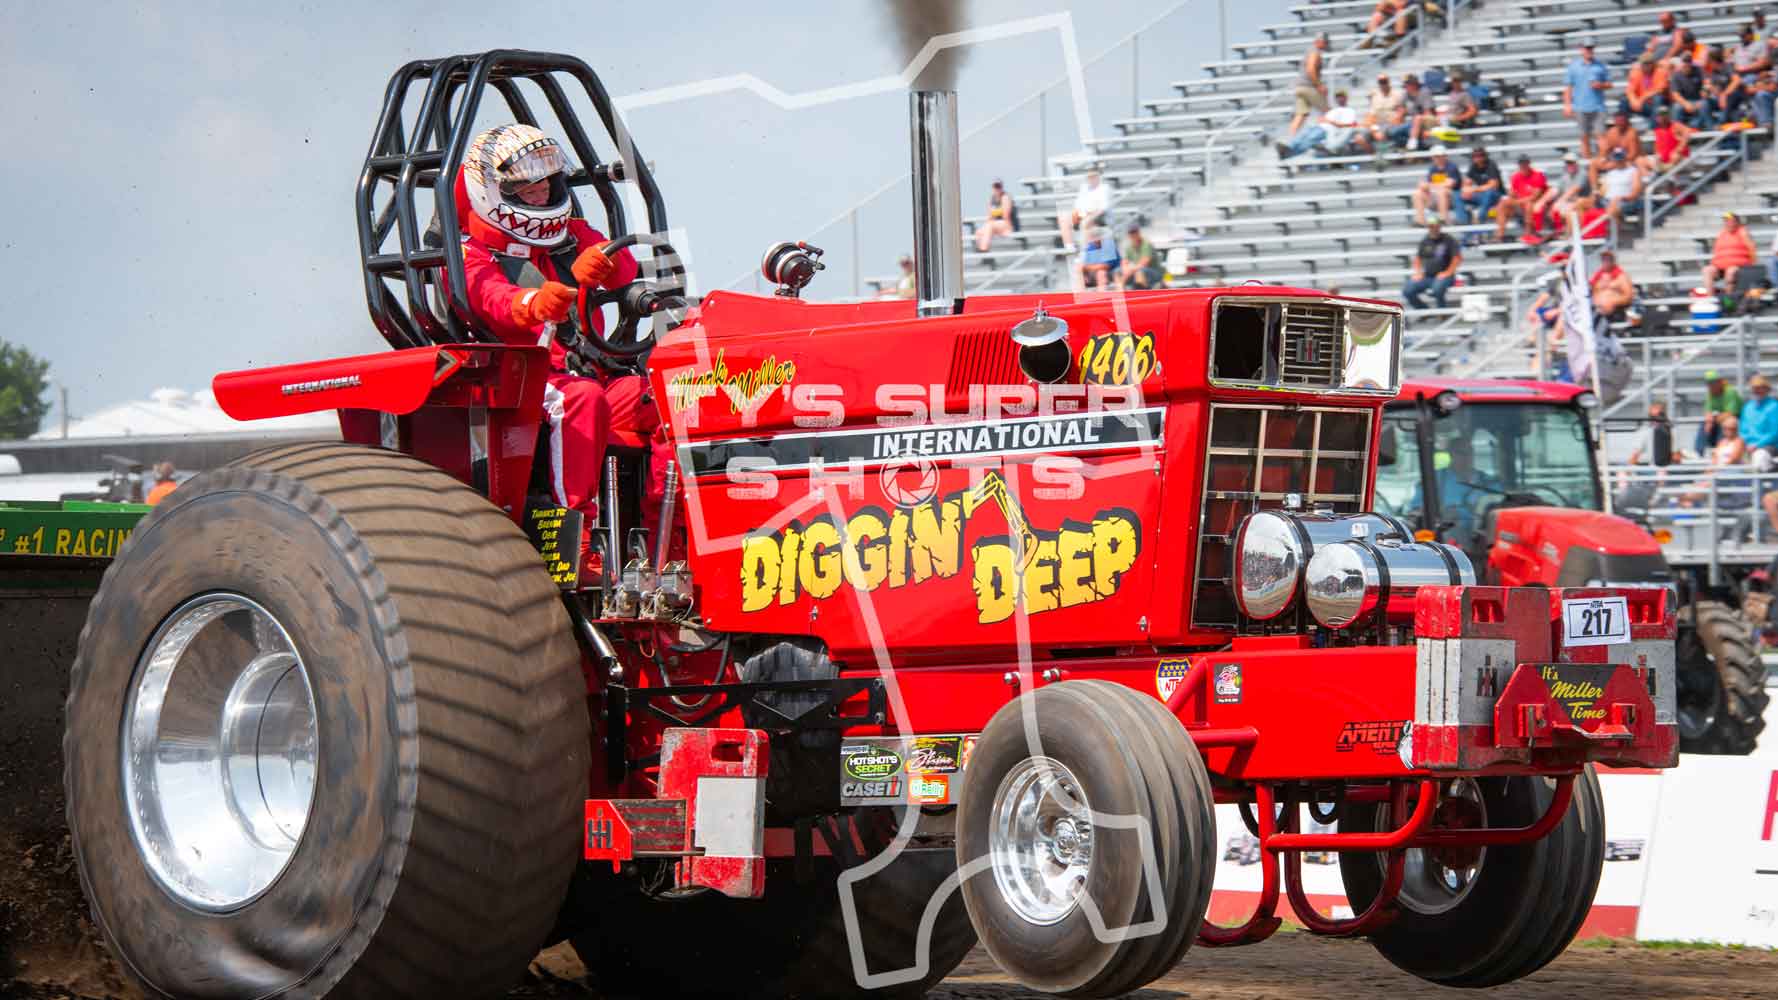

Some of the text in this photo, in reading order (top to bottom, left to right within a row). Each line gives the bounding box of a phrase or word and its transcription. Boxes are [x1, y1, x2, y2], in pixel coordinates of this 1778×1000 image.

[1079, 330, 1156, 386] 1466
[281, 375, 361, 394] INTERNATIONAL
[671, 348, 796, 414] Mark Miller
[872, 418, 1100, 459] INTERNATIONAL
[15, 526, 45, 555] #1
[971, 506, 1142, 624] DEEP
[1582, 608, 1612, 636] 217
[1542, 665, 1559, 680] It's
[1551, 681, 1604, 698] Miller
[1567, 701, 1608, 719] Time
[855, 763, 892, 774] SECRET
[842, 782, 885, 797] CASE
